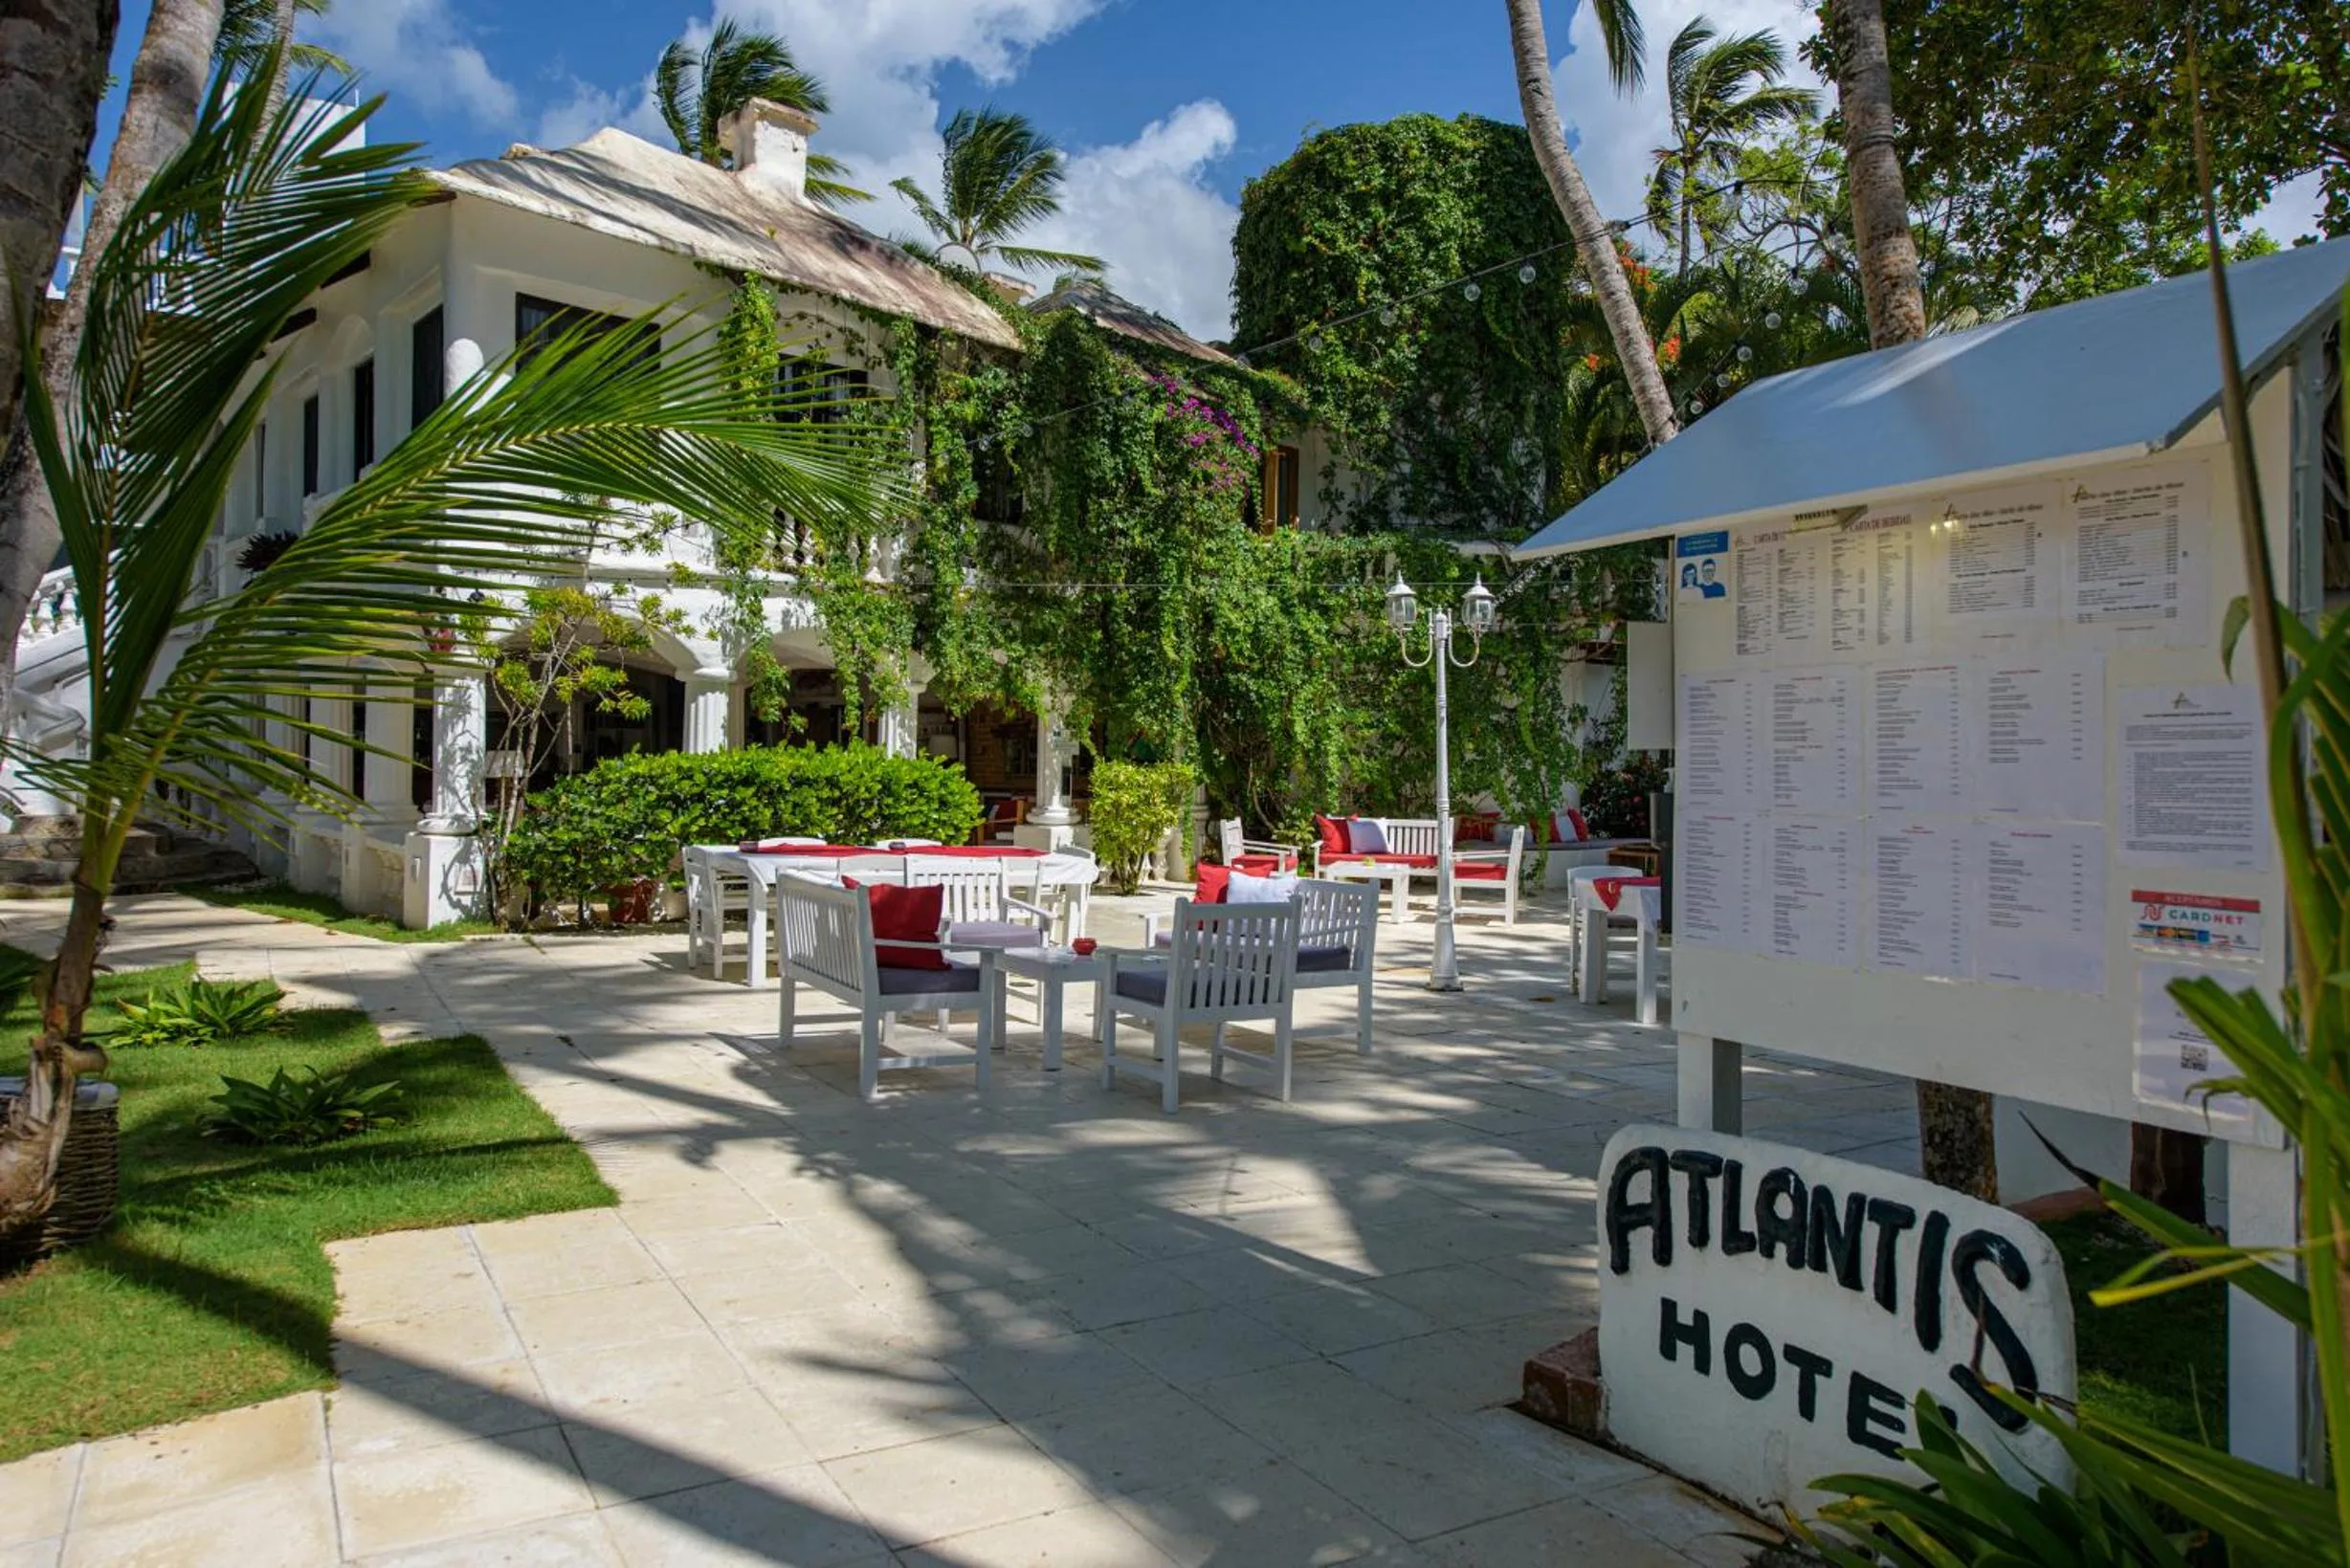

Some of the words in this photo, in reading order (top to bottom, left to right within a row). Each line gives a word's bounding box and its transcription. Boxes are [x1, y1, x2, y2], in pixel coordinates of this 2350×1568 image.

[2168, 908, 2244, 925] CARDNET
[1606, 1145, 2039, 1435] ATLANTIS
[1658, 1295, 1958, 1478] HOTE
